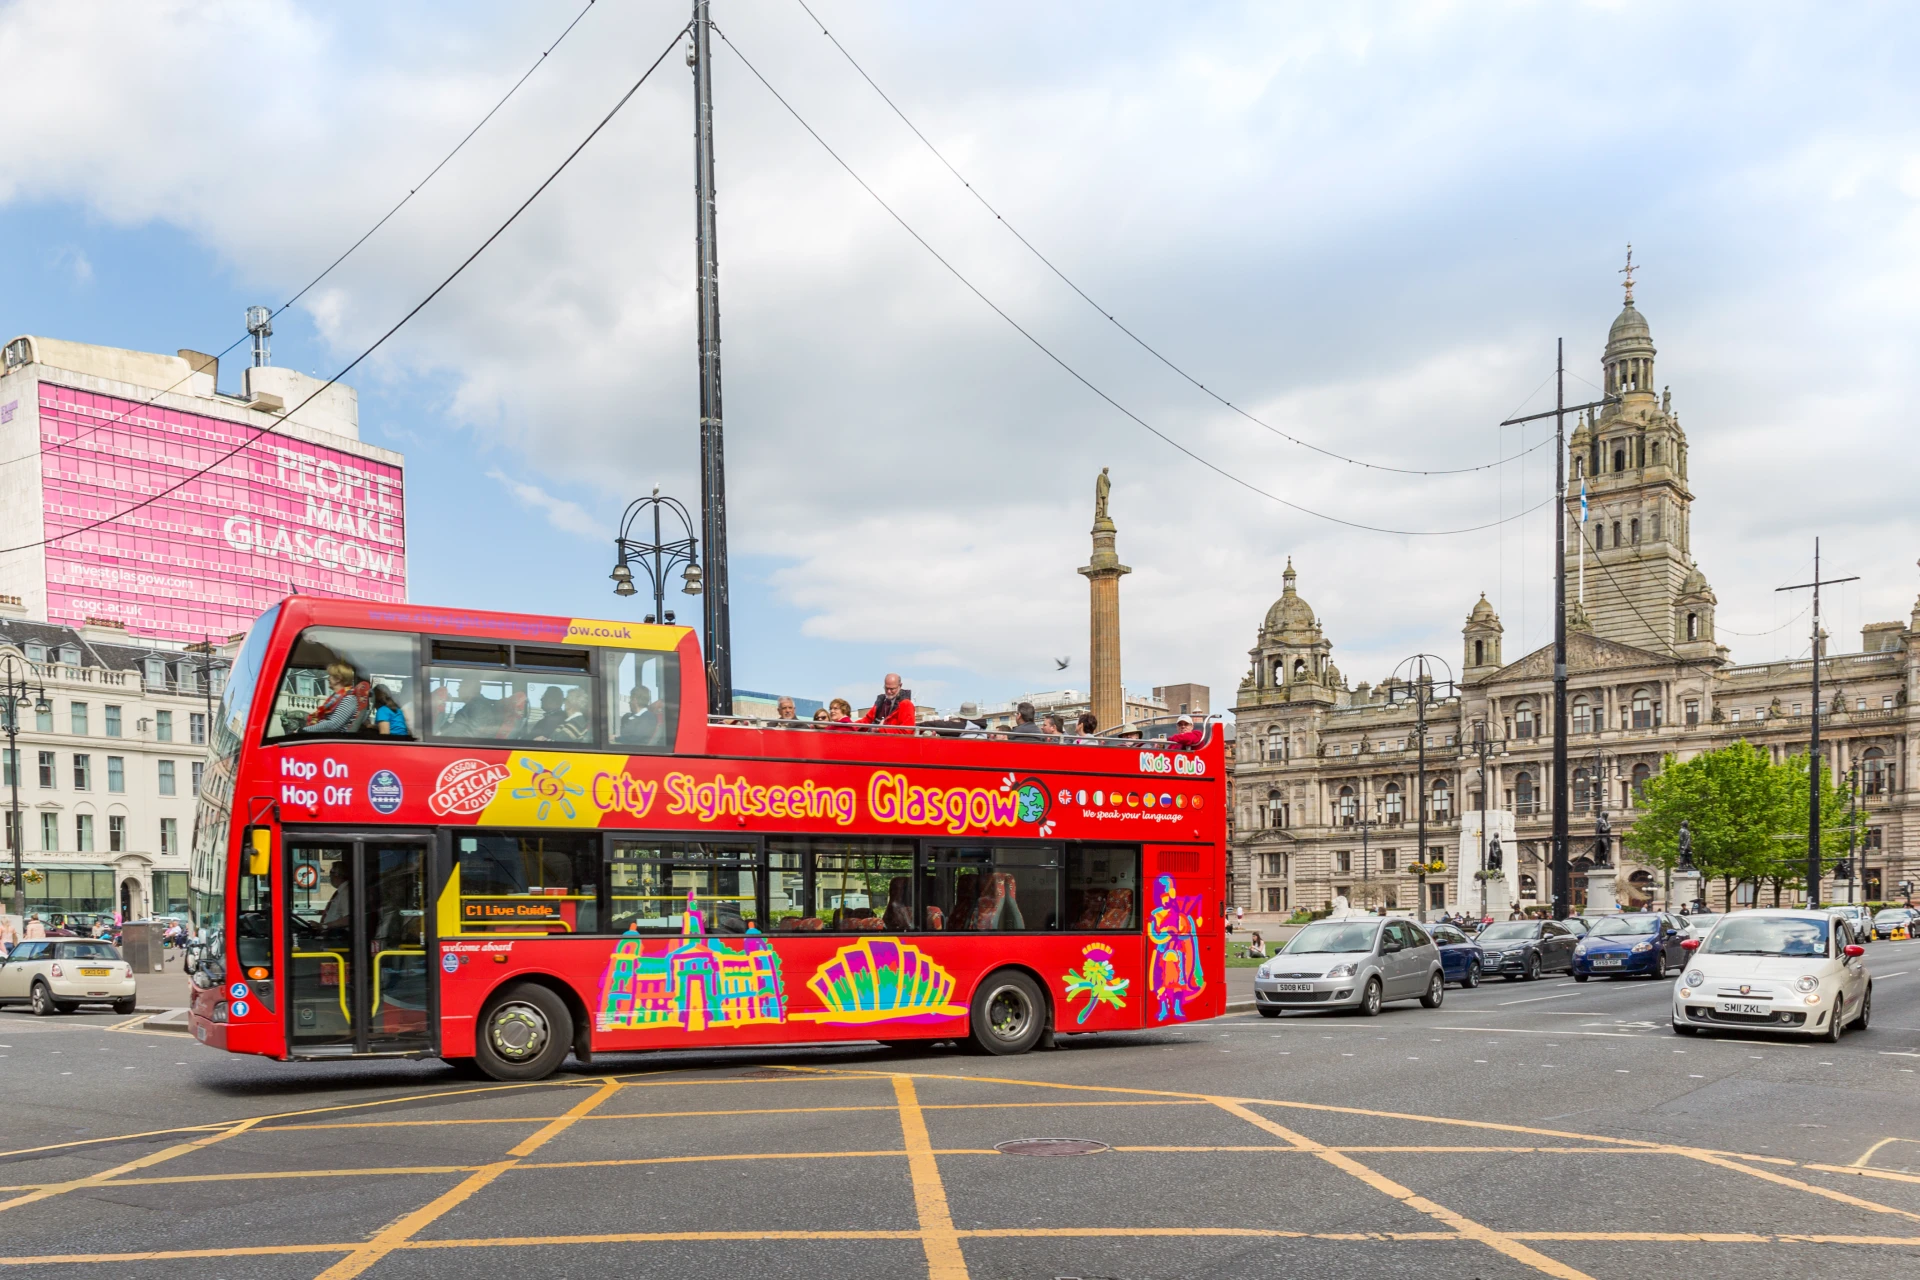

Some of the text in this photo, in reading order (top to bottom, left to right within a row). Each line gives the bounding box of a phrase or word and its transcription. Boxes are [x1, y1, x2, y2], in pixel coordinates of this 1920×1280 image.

[277, 447, 394, 510] PEOPLE
[306, 495, 395, 545] MAKE
[224, 515, 394, 581] GLASGOW
[71, 562, 194, 589] investglasgow.com
[72, 599, 143, 616] cogc.ac.uk
[281, 757, 349, 780] Hop On
[443, 761, 477, 782] GLASGOW
[1140, 752, 1206, 775] Kids Club
[282, 785, 353, 808] Hop Off
[437, 767, 507, 809] OFFICIAL
[464, 788, 495, 810] TOUR
[591, 770, 1020, 834] City Sightseeing Glasgow
[1082, 809, 1184, 823] We speak your language
[465, 905, 554, 916] C1 Live Guide
[441, 941, 515, 952] welcome aboard
[254, 969, 263, 977] 4
[1724, 1003, 1762, 1014] SM11 ZKL
